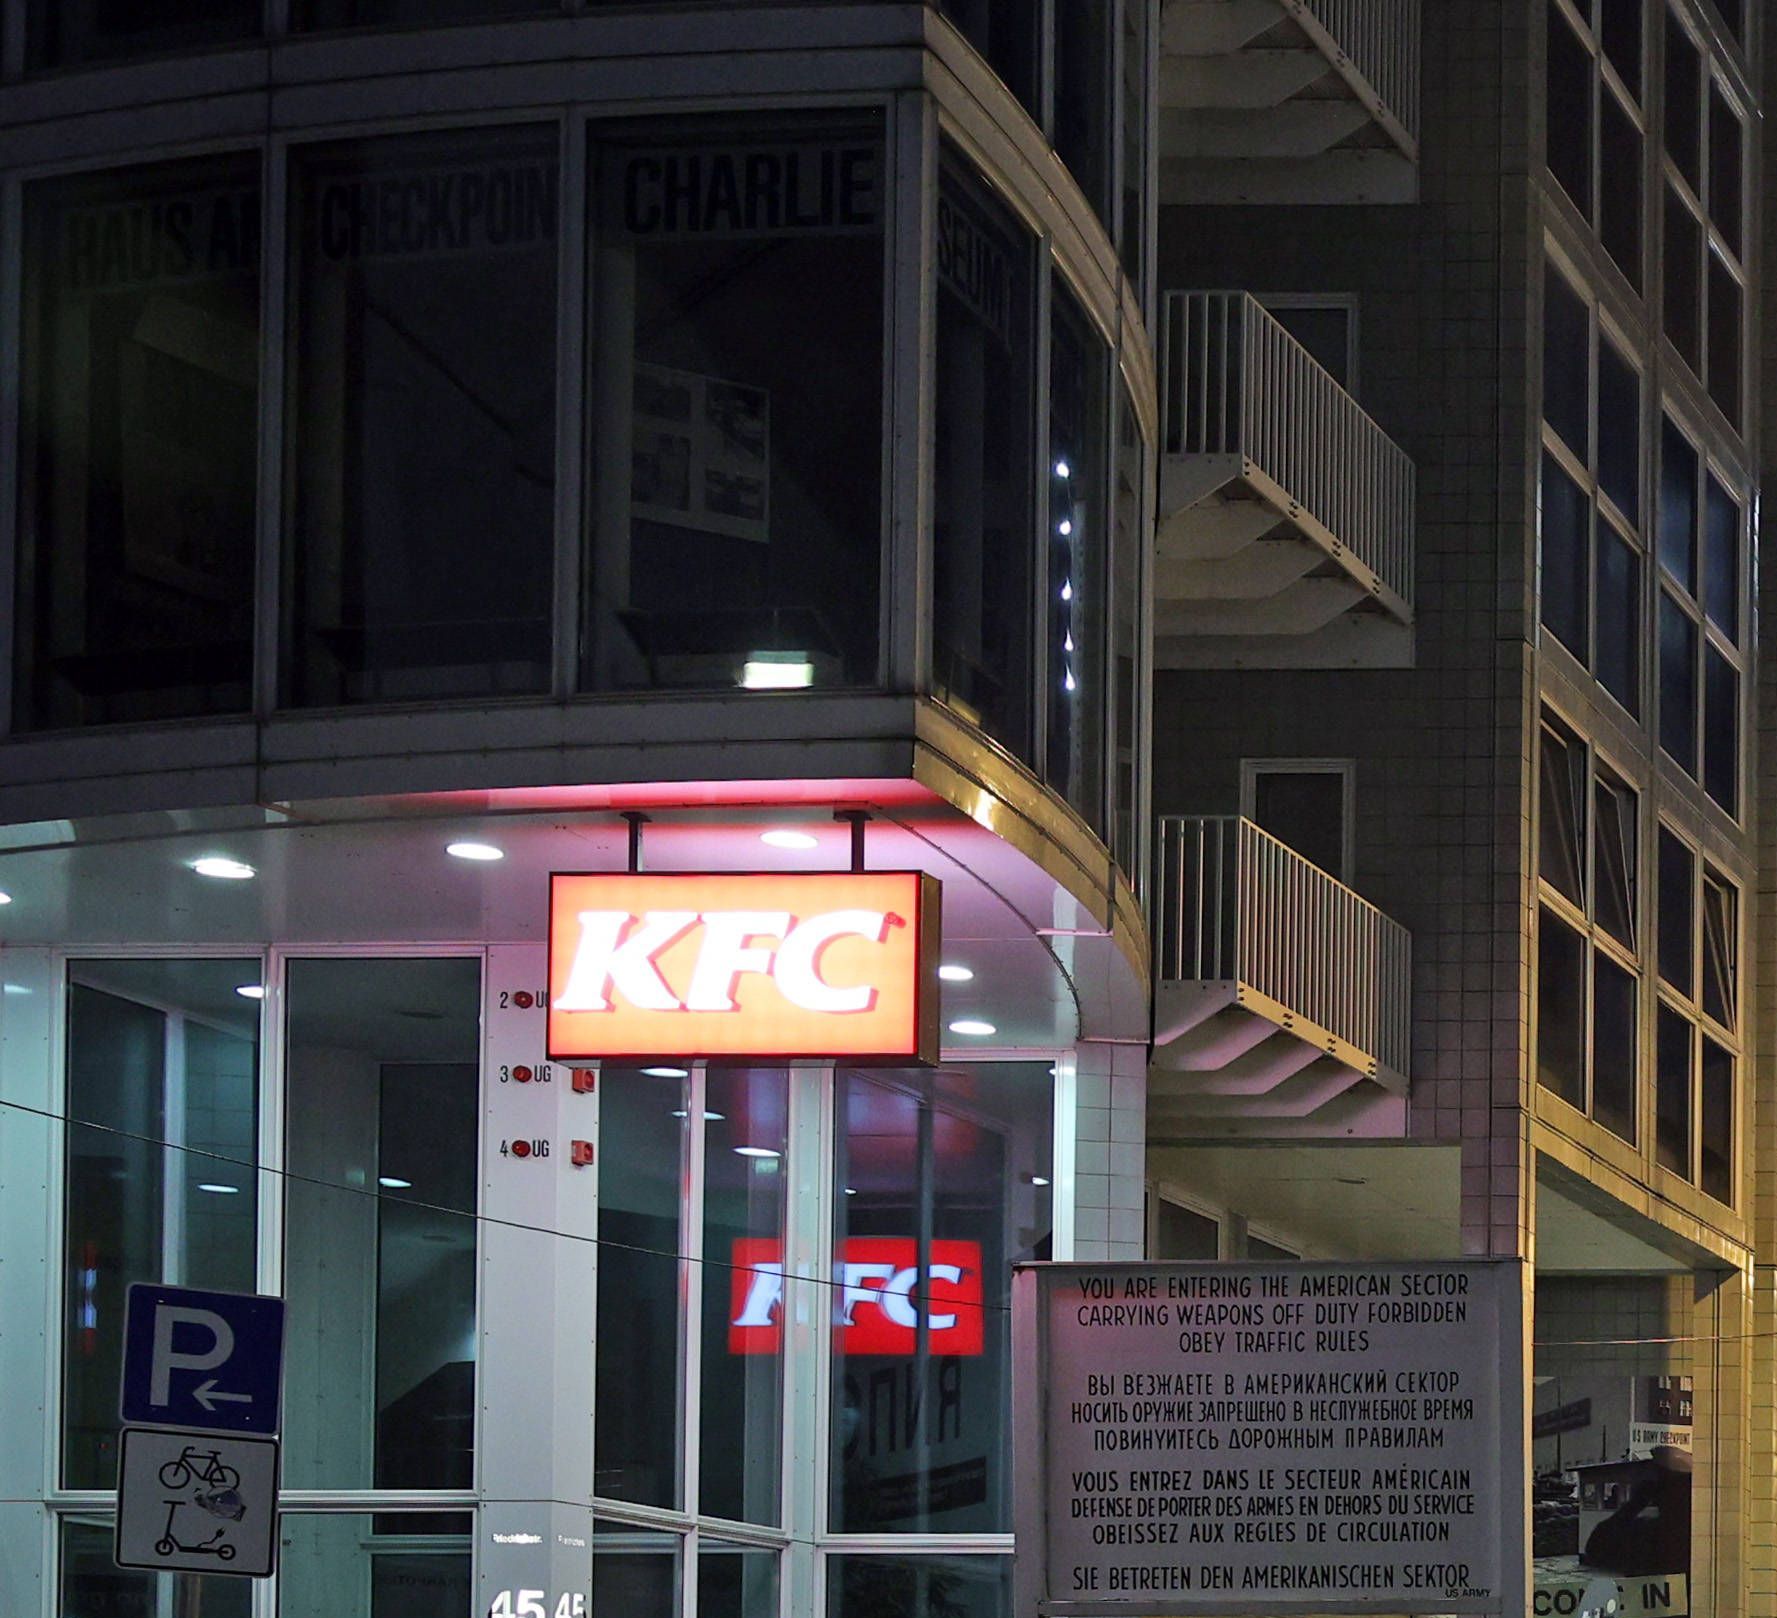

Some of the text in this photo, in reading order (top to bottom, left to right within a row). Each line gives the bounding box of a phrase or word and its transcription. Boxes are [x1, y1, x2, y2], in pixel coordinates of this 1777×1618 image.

[625, 148, 873, 236] CHARLIE
[553, 908, 889, 1016] KFC
[500, 992, 509, 1009] 2
[500, 1065, 552, 1083] 3 UG
[499, 1140, 550, 1158] 4 UG
[1080, 1274, 1468, 1299] YOU ARE ENTERING THE AMERICAN SECTOR
[1078, 1302, 1466, 1326] CARRYING WEAPONS OFF DUTY FORBIDDEN
[1180, 1330, 1369, 1353] OBEY TRAFFIC RULES
[151, 1306, 235, 1406] P
[1088, 1369, 1460, 1396] ВЫ ВЕЗЖАЕТЕ В АМЕРИКАНСКИЙ СЕКТОР
[1072, 1402, 1128, 1424] НОСИТЬ
[1133, 1402, 1193, 1423] ОРУЖИЕ
[1293, 1401, 1303, 1422] В
[1310, 1400, 1417, 1422] НЕСЛУЖЕБНОЕ
[1424, 1399, 1474, 1421] ВРЕМЯ
[1229, 1428, 1334, 1449] ДОРОЖНЫМ
[1345, 1427, 1443, 1448] ПРАВИЛАМ
[1072, 1471, 1118, 1491] VOUS
[1130, 1471, 1191, 1490] ENTREZ
[1204, 1470, 1249, 1490] DANS
[1260, 1470, 1275, 1490] LE
[1285, 1469, 1361, 1490] SECTEUR
[1072, 1494, 1475, 1518] DEFENSE DE PORTER DES ARMES EN DEHORS DU SERVICE
[1093, 1521, 1449, 1544] OBEISSEZ AUX REGLES DE CIRCULATION
[1073, 1564, 1470, 1590] SIE BETRETEN DEN AMERIKANISCHEN SEKTOR
[1445, 1588, 1491, 1598] US ARMY
[1642, 1582, 1671, 1609] IN
